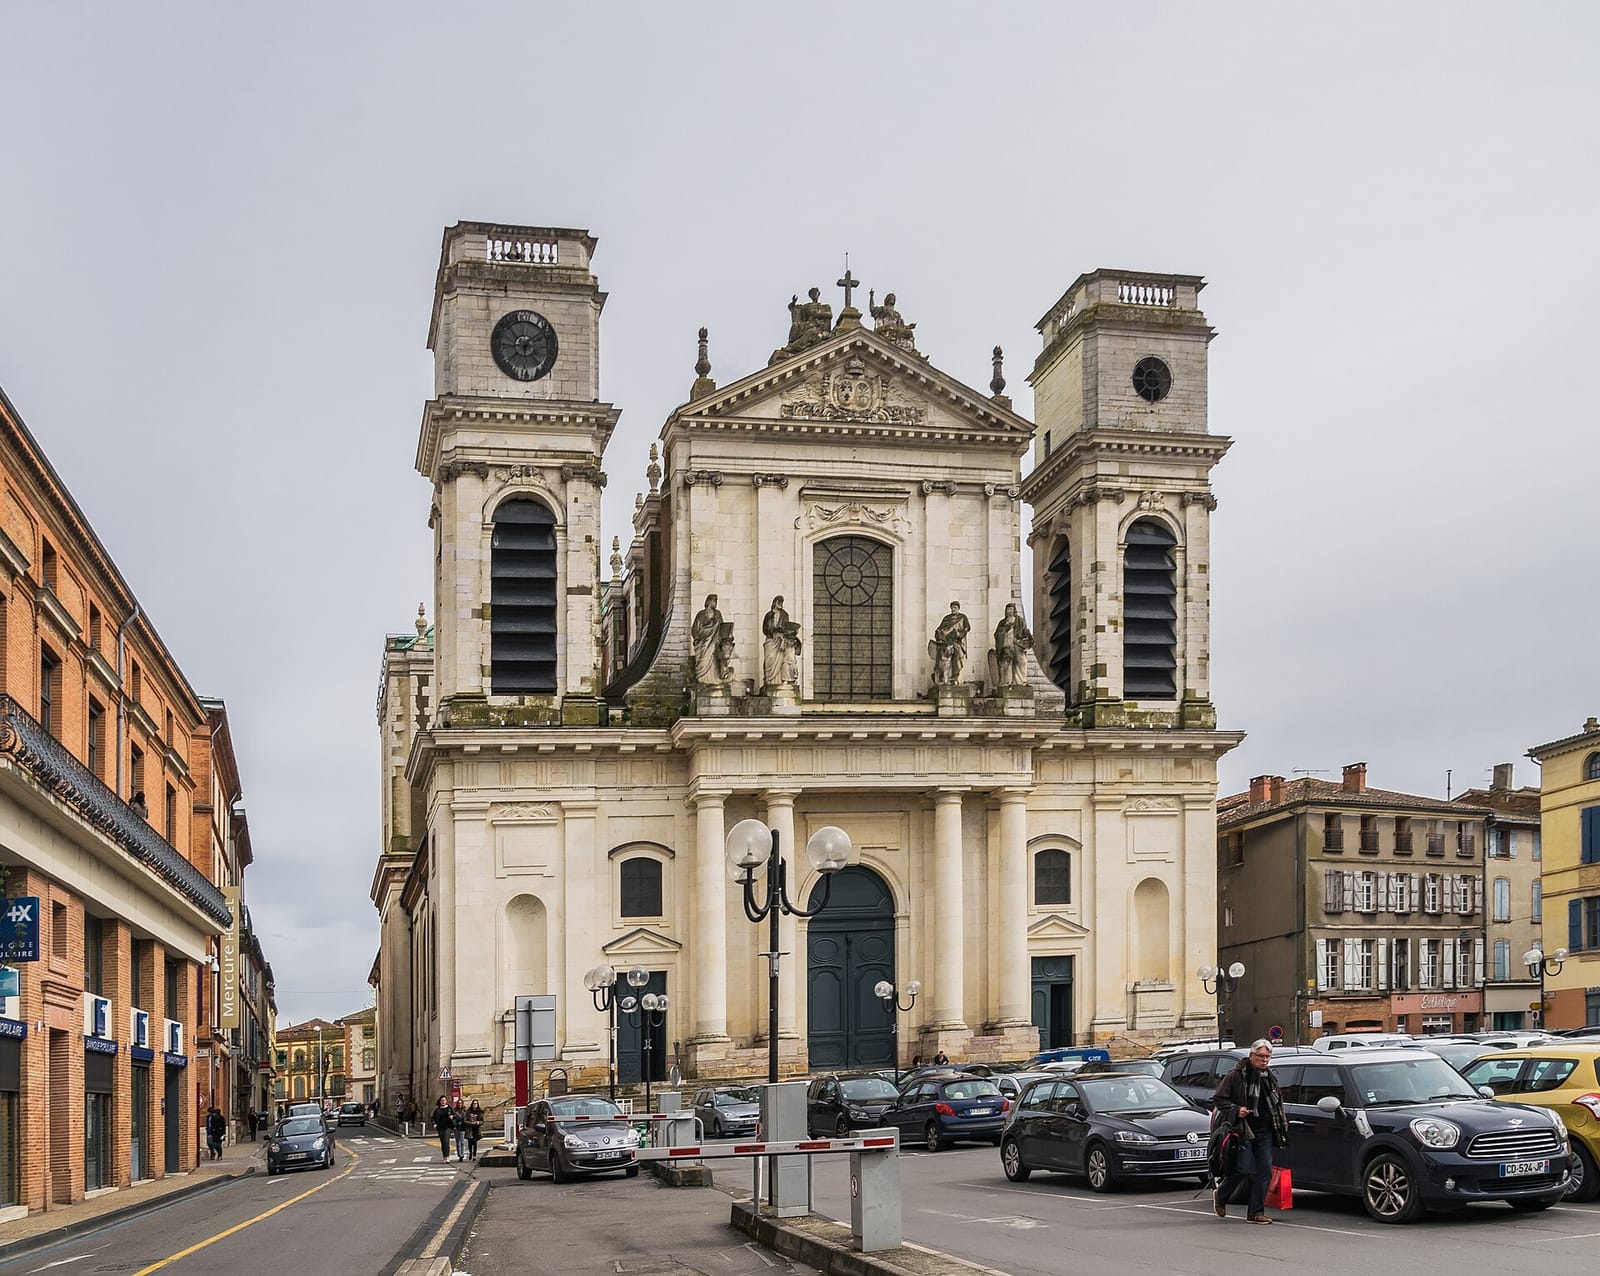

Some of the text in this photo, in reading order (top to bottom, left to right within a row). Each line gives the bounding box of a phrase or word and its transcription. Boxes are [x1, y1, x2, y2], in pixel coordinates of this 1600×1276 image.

[222, 897, 235, 1017] Mercure HOEL
[0, 1022, 23, 1036] OPULAIRE
[1506, 1161, 1544, 1174] CD-524-JP
